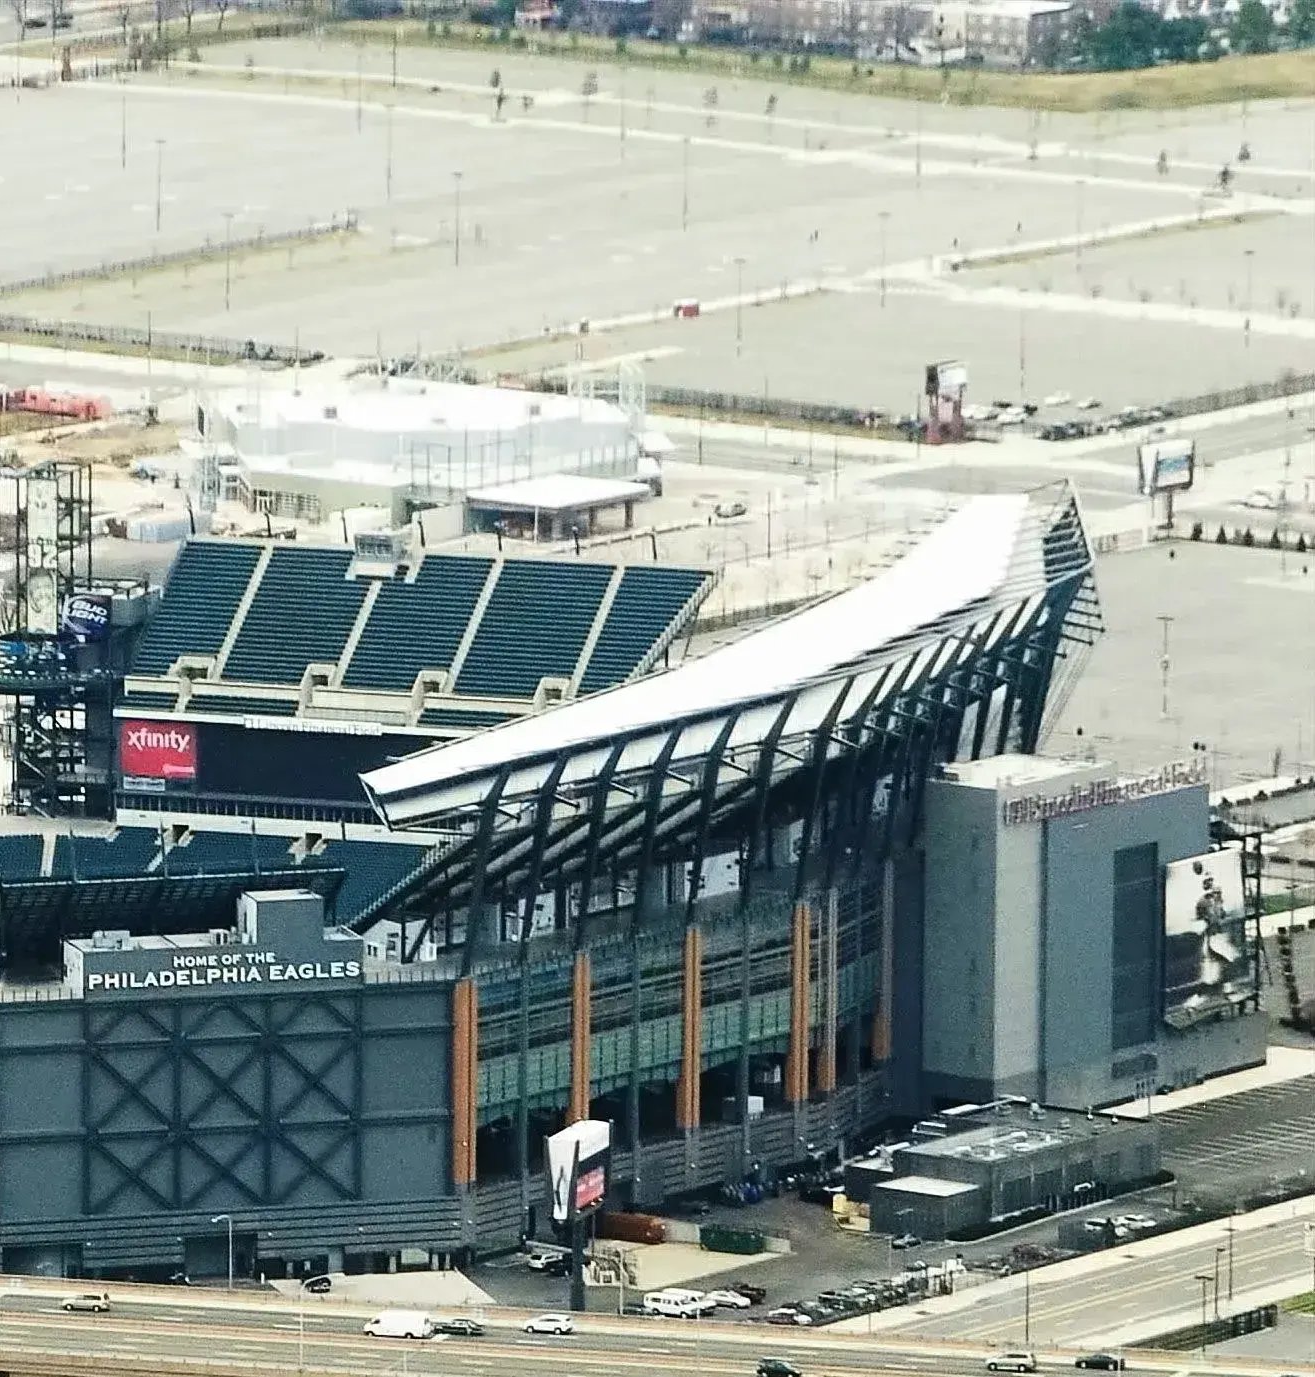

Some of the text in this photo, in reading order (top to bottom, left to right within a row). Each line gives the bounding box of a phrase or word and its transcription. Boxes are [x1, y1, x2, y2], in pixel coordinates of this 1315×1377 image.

[72, 600, 108, 616] BUD
[127, 727, 190, 753] xfinity
[173, 952, 276, 968] HOME OF THE
[88, 961, 360, 990] PHILADELPHIA EAGLES
